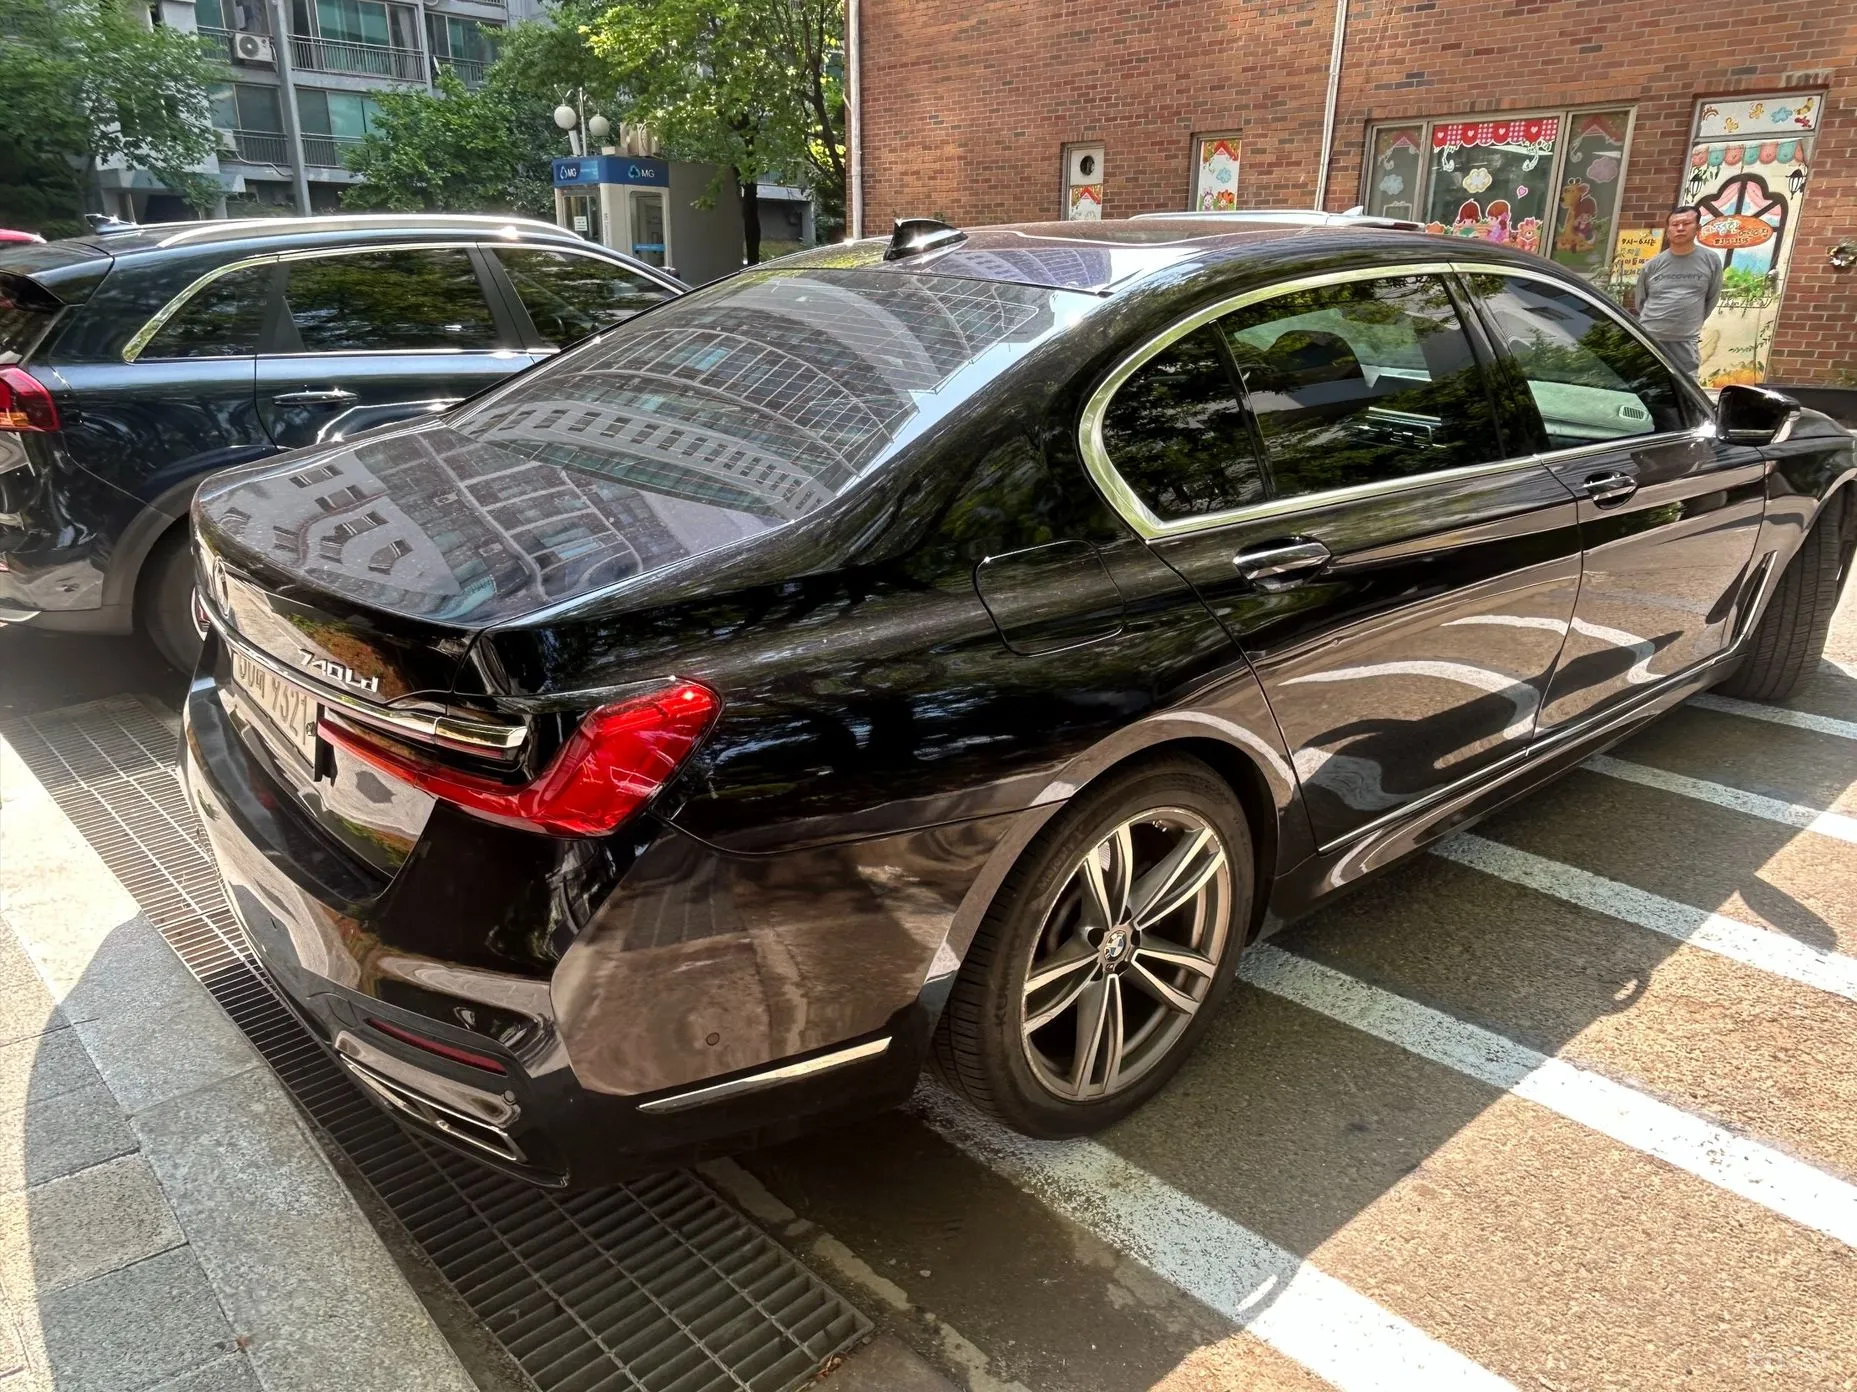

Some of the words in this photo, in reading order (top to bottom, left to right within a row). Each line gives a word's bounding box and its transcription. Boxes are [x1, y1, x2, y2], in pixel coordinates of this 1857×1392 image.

[567, 168, 577, 178] MG
[641, 169, 655, 179] MG
[298, 649, 378, 692] 740Ld
